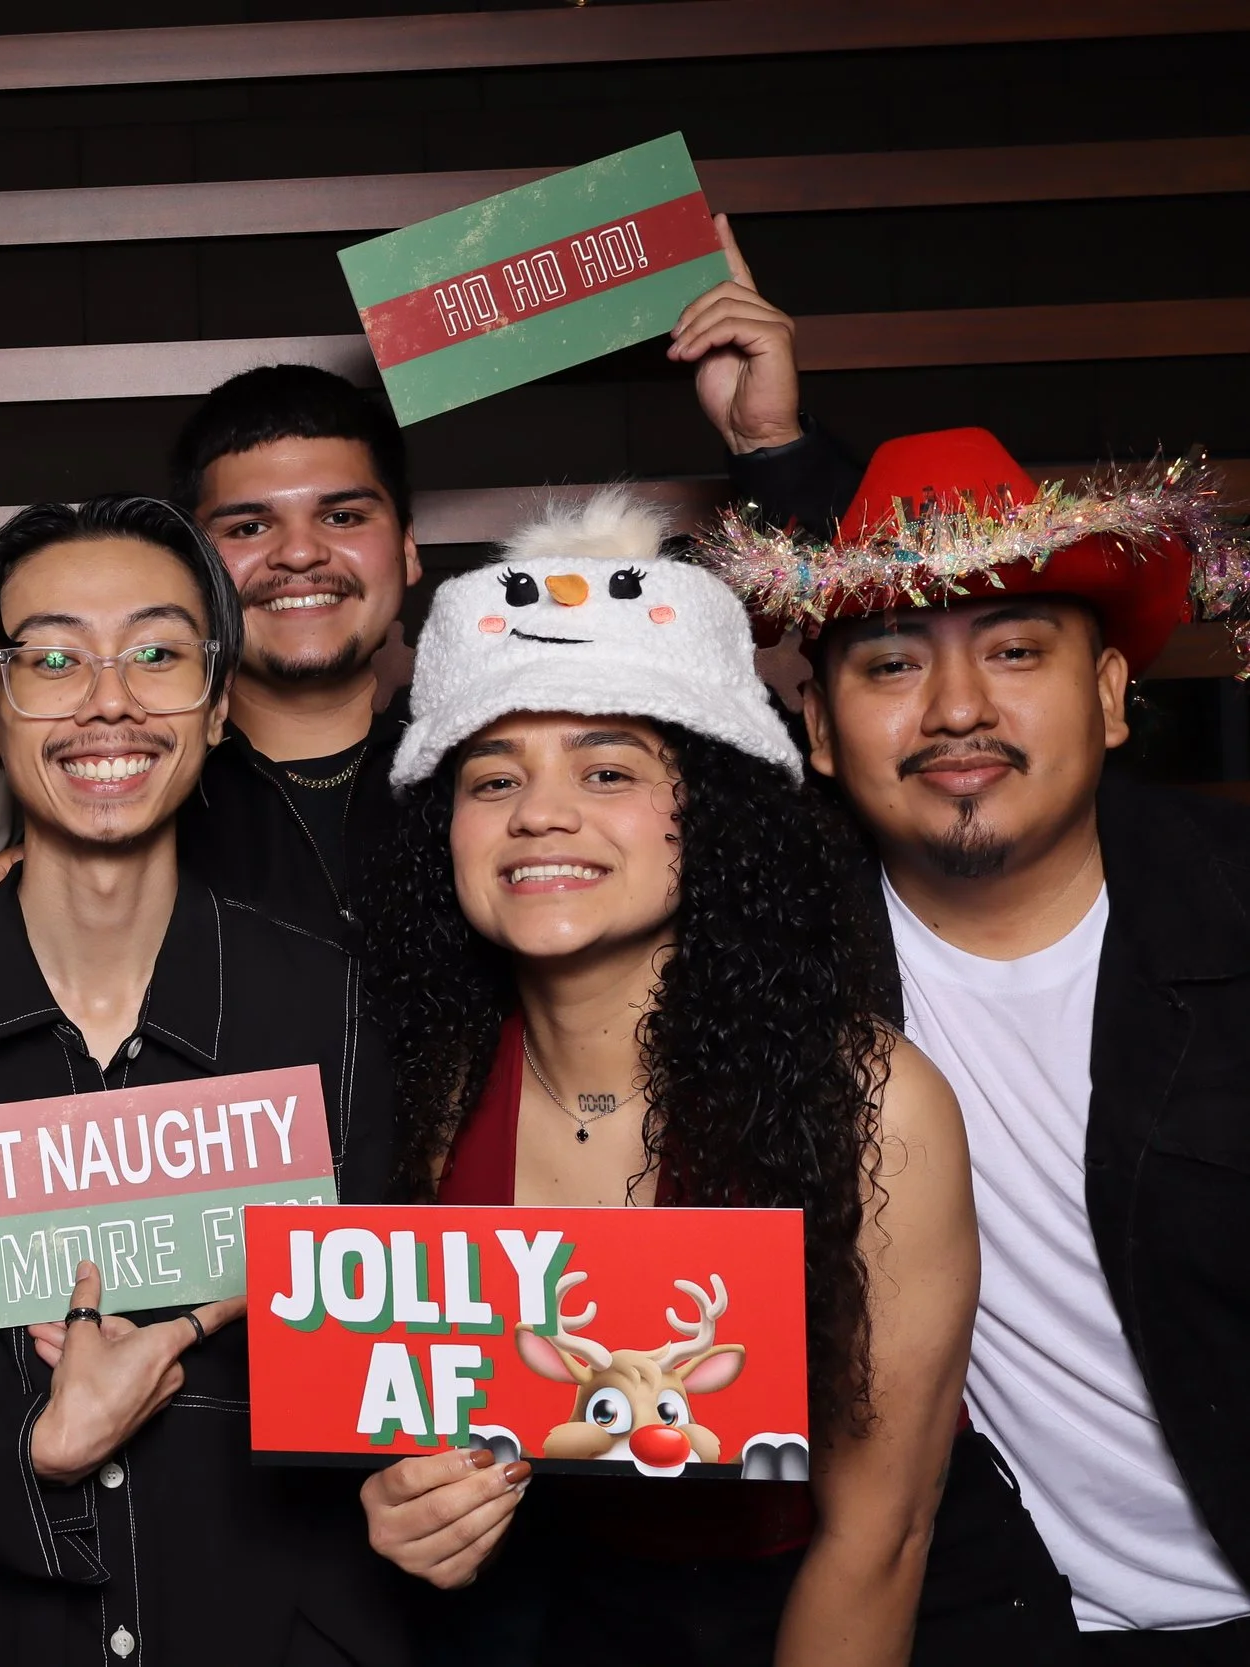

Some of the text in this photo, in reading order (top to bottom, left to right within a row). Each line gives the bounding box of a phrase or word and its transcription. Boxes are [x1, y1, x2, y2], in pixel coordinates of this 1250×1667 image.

[433, 220, 649, 337] HO HO HO!
[37, 1095, 299, 1195] NAUGHTY
[0, 1213, 183, 1304] MORE
[269, 1228, 567, 1328] JOLLY
[355, 1341, 486, 1440] AF
